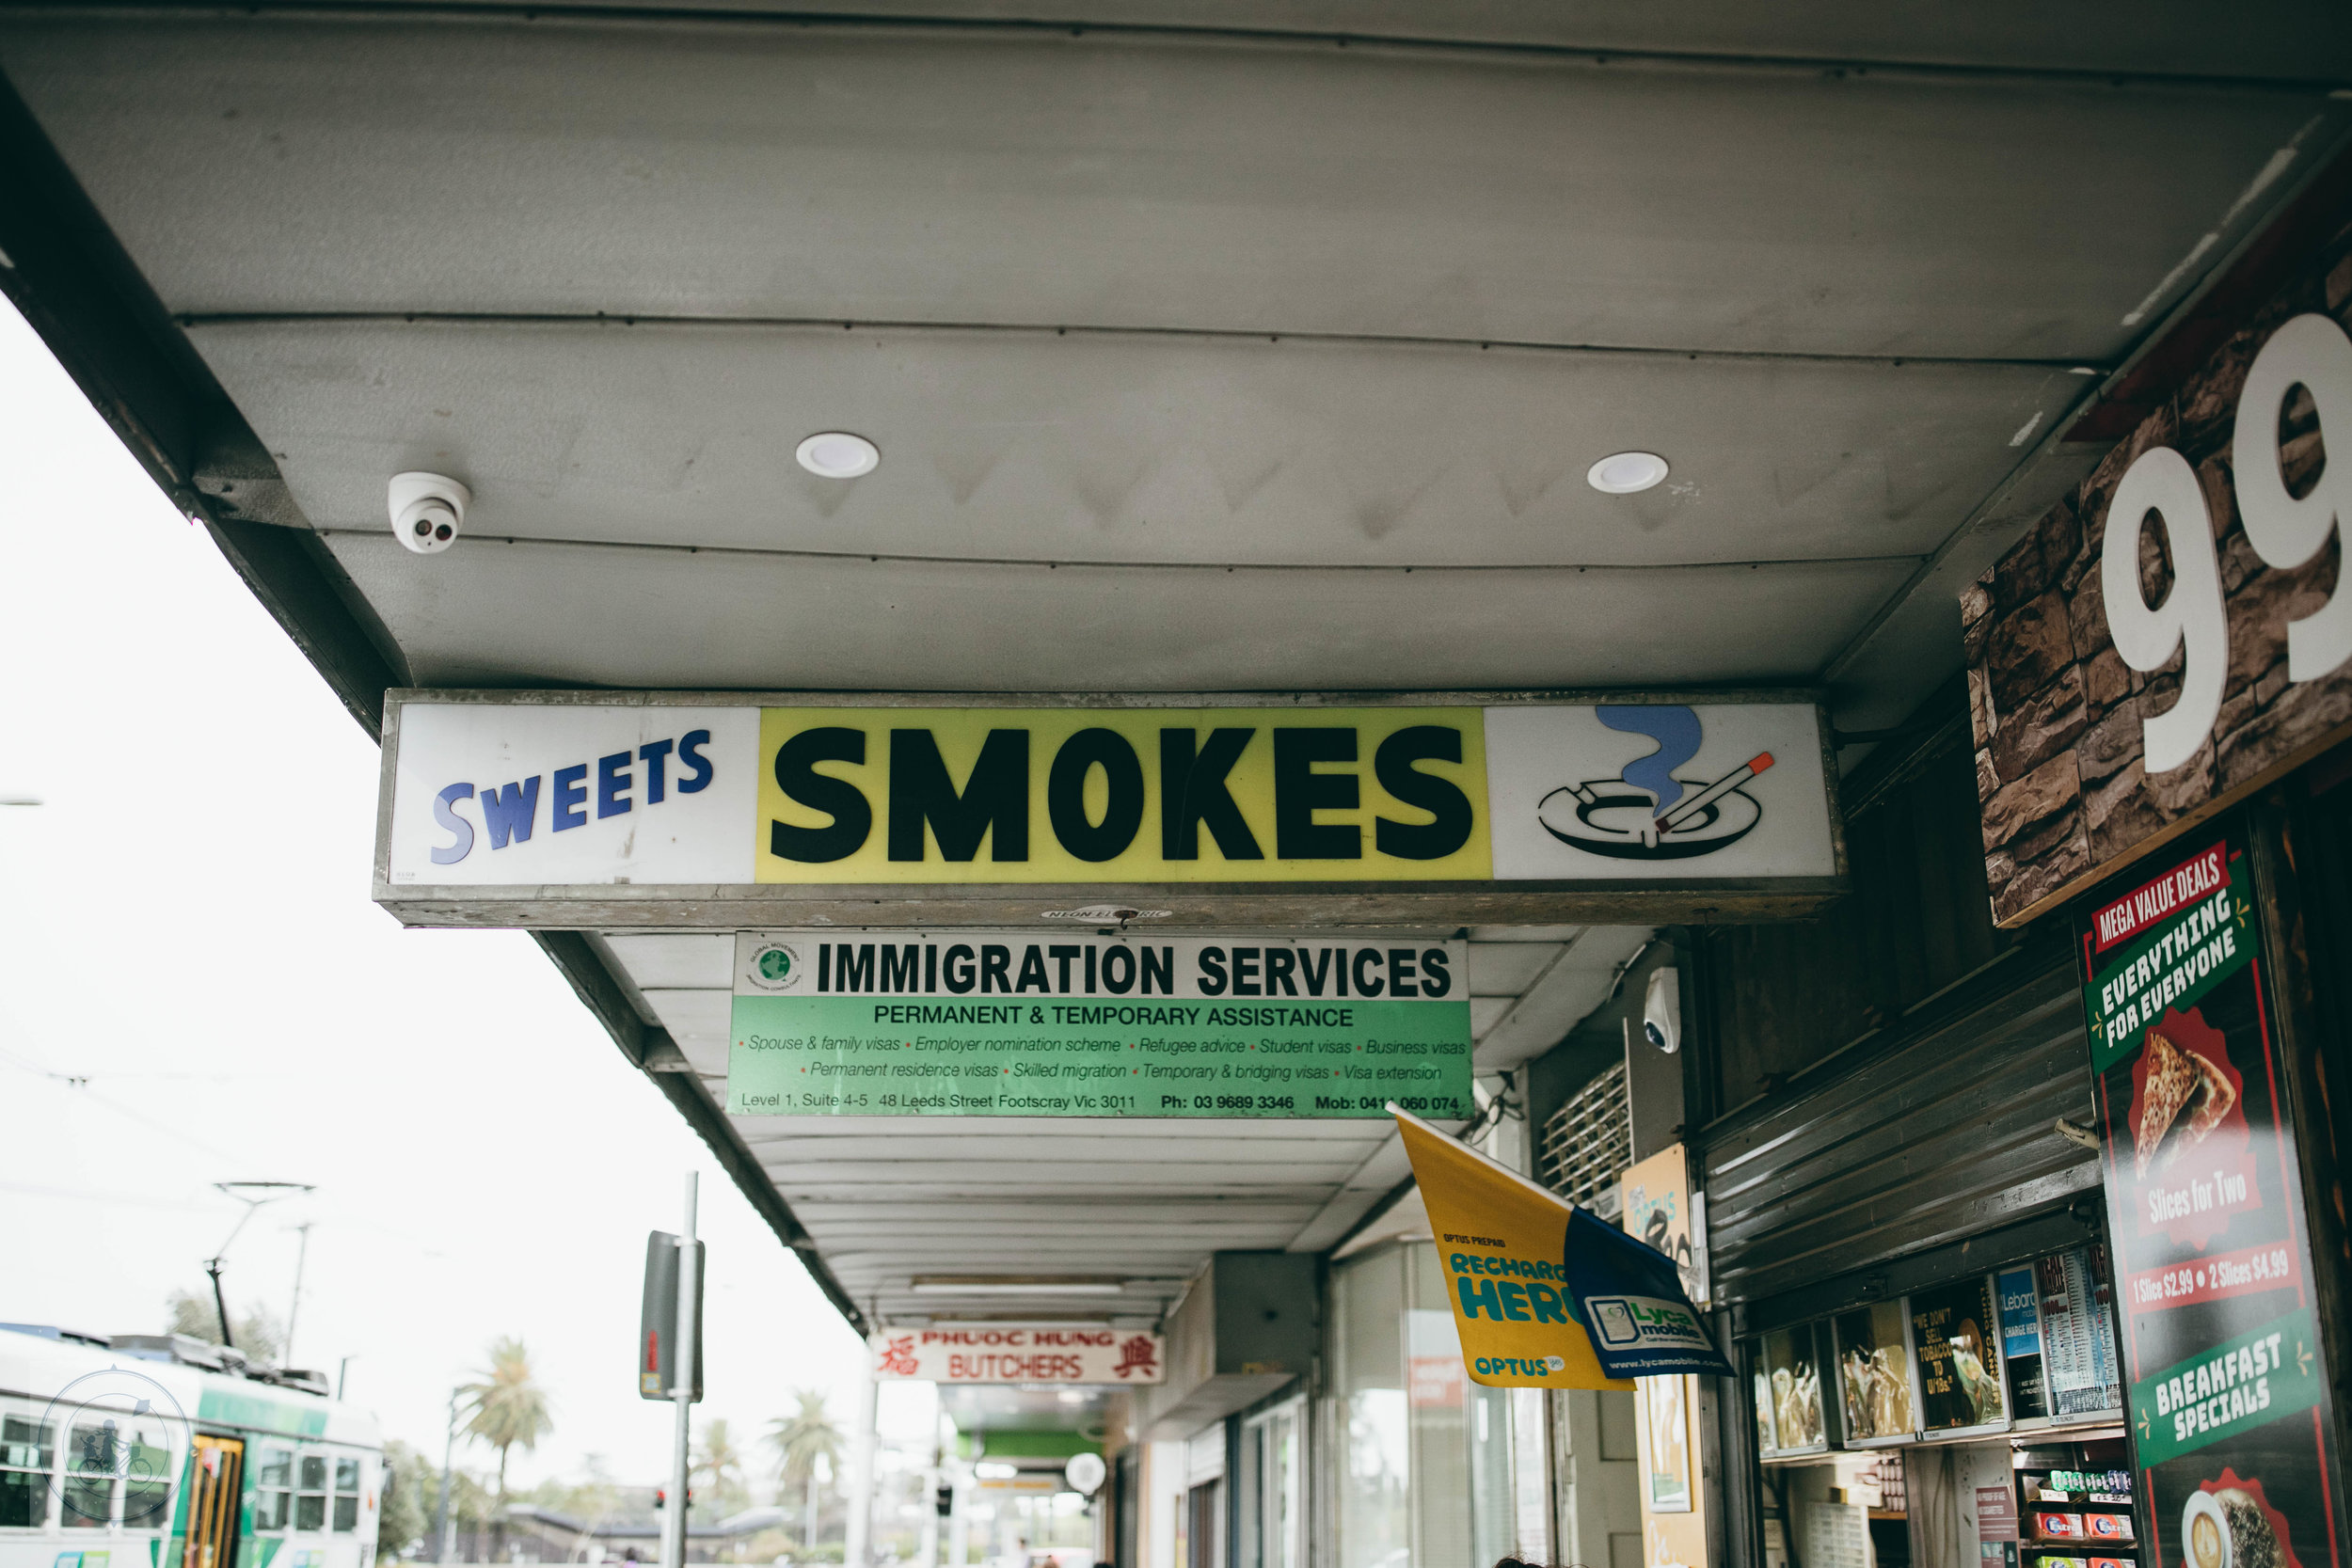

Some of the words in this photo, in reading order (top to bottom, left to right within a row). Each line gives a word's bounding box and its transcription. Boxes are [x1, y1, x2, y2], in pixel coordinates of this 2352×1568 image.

[430, 729, 713, 864] SWEETS
[771, 726, 1473, 863] SMOKES
[2099, 900, 2136, 943] MEGA
[2135, 881, 2176, 924] VALUE
[2175, 852, 2220, 902] DEALS
[750, 943, 770, 962] GLOBAL
[771, 942, 800, 961] MOVEMENT
[2101, 888, 2232, 1016] EVERYTHING
[817, 943, 1174, 995] IMMIGRATION
[1197, 946, 1452, 997] SERVICES
[2106, 1004, 2139, 1049] FOR
[2139, 926, 2236, 1022] EVERYONE
[874, 1006, 1024, 1023] PERMANENT
[1029, 1006, 1045, 1024] &
[1052, 1006, 1200, 1025] TEMPORARY
[1206, 1007, 1354, 1027] ASSISTANCE
[748, 1035, 803, 1053] Spouse
[806, 1036, 817, 1050] &
[821, 1036, 863, 1053] family
[866, 1037, 900, 1051] visas
[914, 1037, 980, 1053] Employer
[984, 1037, 1061, 1052] nomination
[1065, 1037, 1121, 1053] scheme
[1138, 1038, 1197, 1055] Refugee
[1200, 1038, 1246, 1053] advice
[1259, 1038, 1314, 1054] Student
[1317, 1040, 1352, 1054] visas
[1365, 1039, 1428, 1055] Business
[1432, 1041, 1466, 1055] visas
[810, 1061, 888, 1077] Permanent
[891, 1062, 961, 1077] residence
[963, 1063, 998, 1078] visas
[1012, 1062, 1059, 1078] Skilled
[1061, 1064, 1127, 1081] migration
[1143, 1063, 1217, 1082] Temporary
[1221, 1064, 1232, 1079] &
[1235, 1065, 1292, 1082] bridging
[1295, 1065, 1329, 1080] visas
[1343, 1065, 1373, 1080] Visa
[1376, 1066, 1442, 1081] extension
[741, 1093, 780, 1106] Level
[786, 1093, 797, 1108] 1,
[802, 1093, 839, 1106] Suite
[843, 1094, 868, 1106] 4-5
[879, 1094, 897, 1107] 48
[901, 1094, 946, 1107] Leeds
[949, 1094, 993, 1108] Street
[999, 1095, 1071, 1111] Footscray
[1074, 1095, 1097, 1108] Vic
[1100, 1096, 1136, 1109] 3011
[1161, 1096, 1187, 1109] Ph:
[1194, 1096, 1213, 1109] 03
[1216, 1096, 1254, 1109] 9689
[1257, 1096, 1295, 1109] 3346
[1314, 1097, 1356, 1110] Mob:
[1359, 1097, 1394, 1110] 041
[1400, 1097, 1427, 1110] 060
[1431, 1098, 1459, 1110] 074
[2148, 1188, 2191, 1224] Slices
[2191, 1179, 2213, 1212] for
[2214, 1170, 2247, 1207] Two
[1443, 1233, 1470, 1244] OPTUS
[1471, 1236, 1505, 1248] PREPAID
[1450, 1253, 1567, 1282] RECHARG
[2133, 1280, 2139, 1304] 1
[2139, 1276, 2163, 1302] Slice
[2163, 1268, 2194, 1298] $2.99
[2209, 1263, 2218, 1290] 2
[2217, 1260, 2252, 1287] Slices
[2252, 1248, 2289, 1282] $4.99
[1629, 1302, 1693, 1326] Lyca
[1640, 1323, 1702, 1339] mobile
[1925, 1327, 1943, 1344] SELL
[2026, 1323, 2038, 1335] HER
[921, 1331, 1027, 1347] PHUOC
[1034, 1331, 1116, 1347] HUNG
[878, 1336, 919, 1376] 福
[1918, 1341, 1953, 1363] TOBACCO
[948, 1354, 1082, 1379] BUTCHERS
[1475, 1357, 1548, 1376] OPTUS
[1609, 1357, 1725, 1370] www.lycamobile.com
[1931, 1360, 1944, 1377] TO
[2155, 1332, 2281, 1418] BREAKFAST
[2174, 1376, 2271, 1442] SPECIALS
